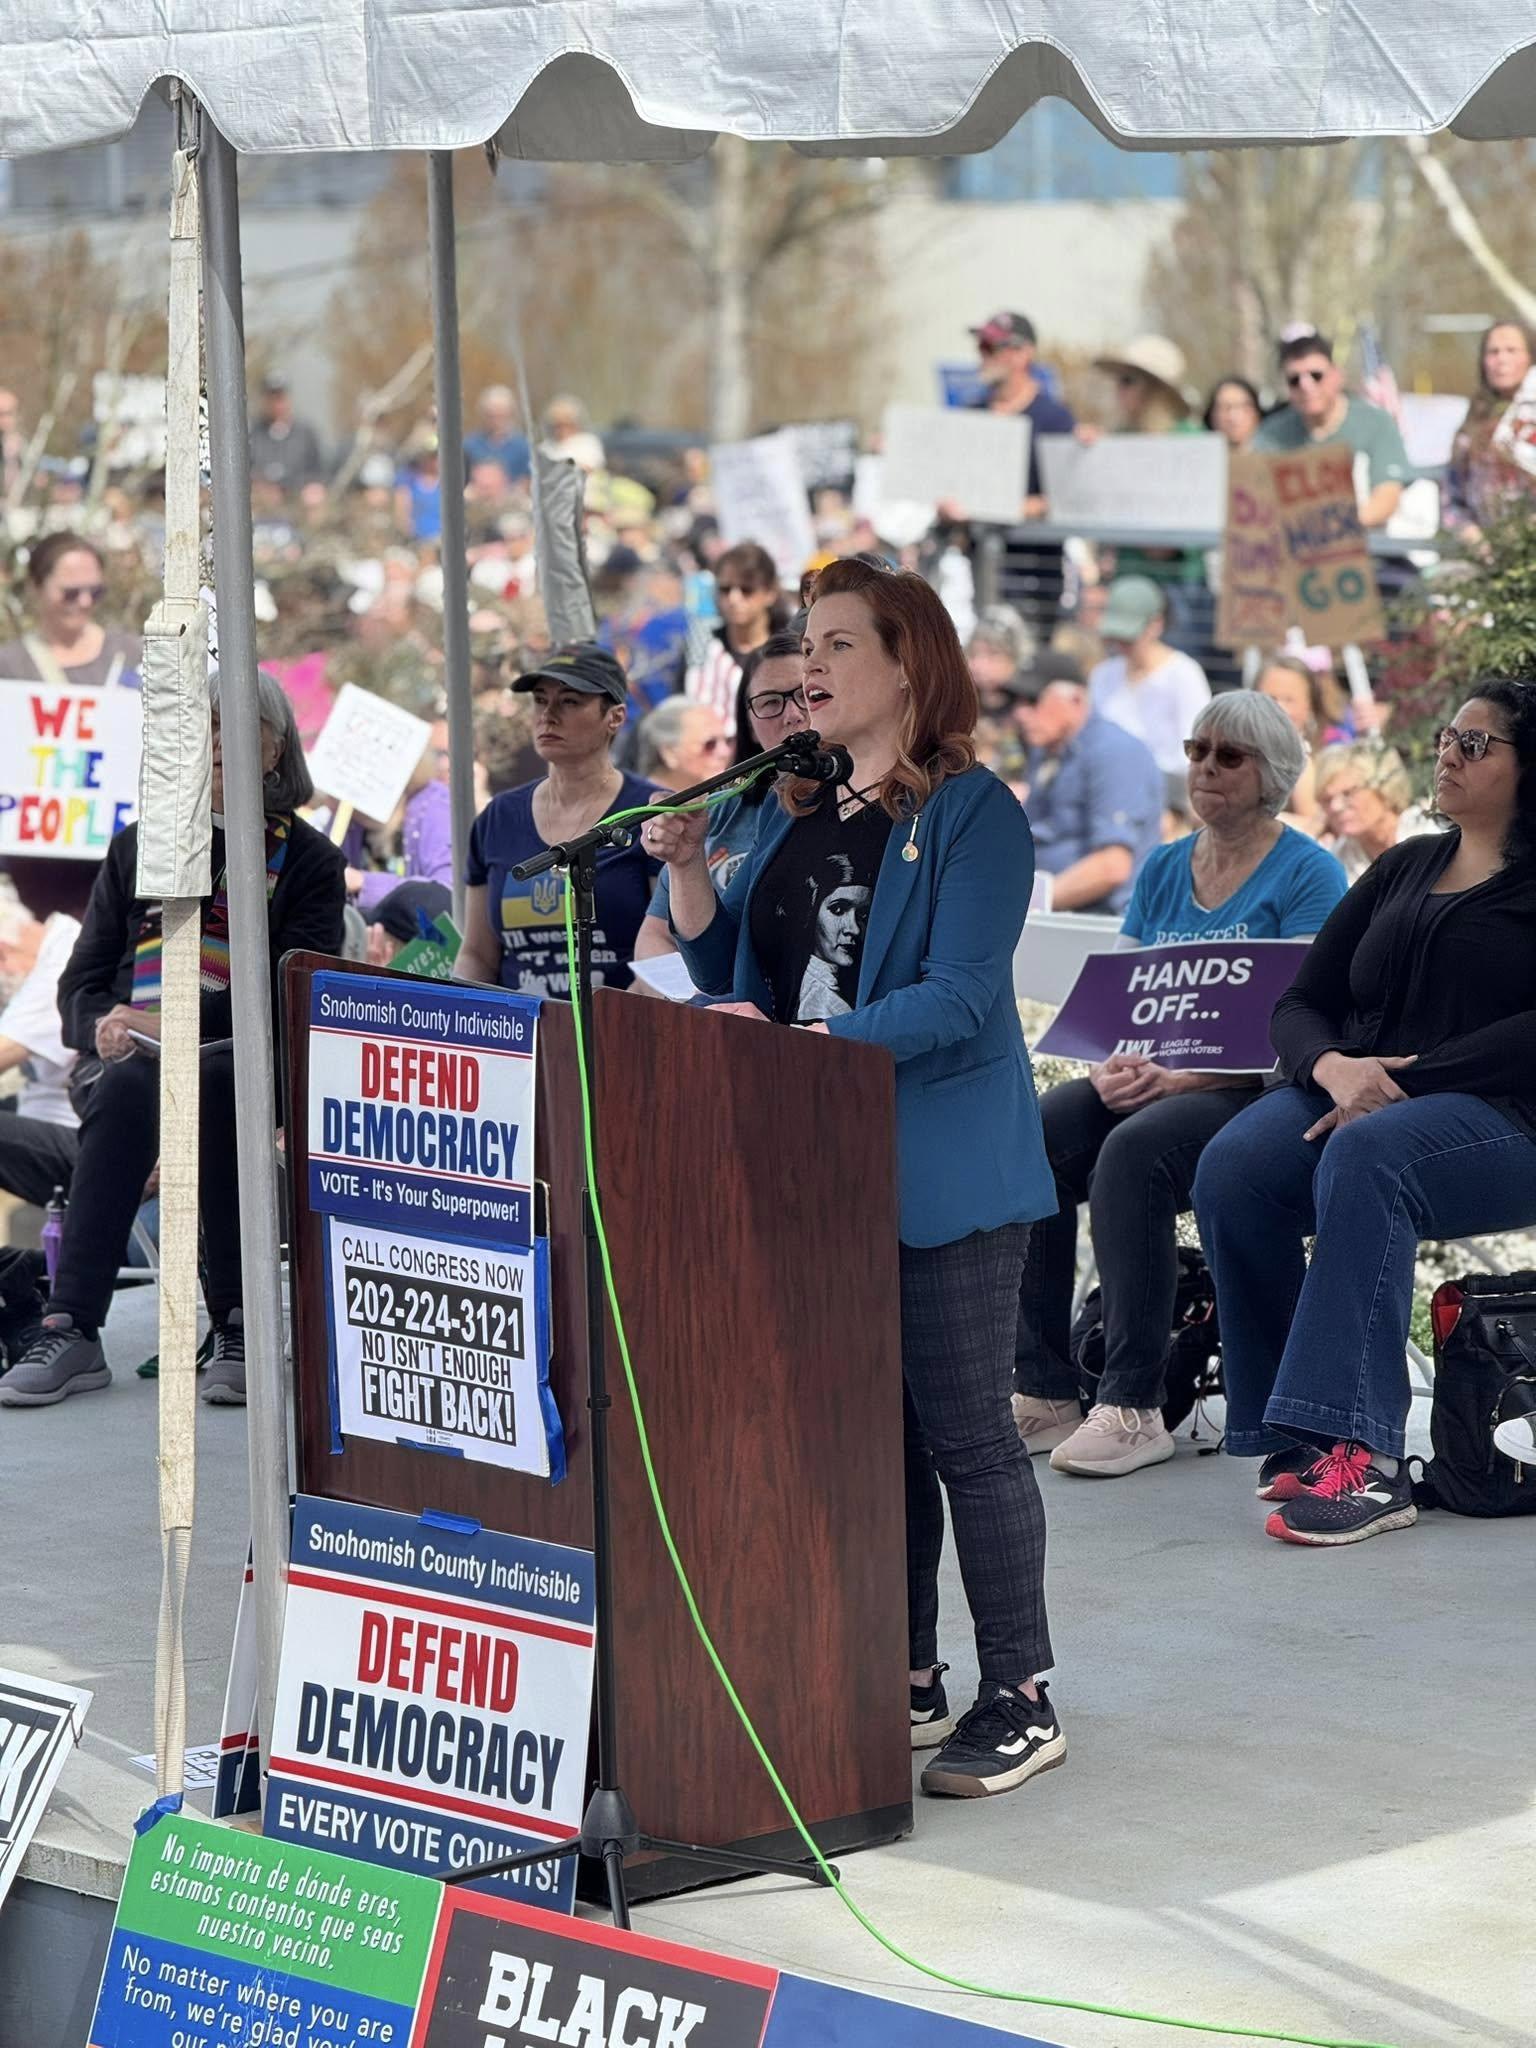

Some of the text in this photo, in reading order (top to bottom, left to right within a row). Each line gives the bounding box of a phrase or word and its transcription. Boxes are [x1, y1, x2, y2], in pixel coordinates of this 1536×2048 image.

[1297, 567, 1366, 611] GO
[30, 695, 96, 739] WE
[28, 746, 103, 788] THE
[1127, 957, 1253, 993] HANDS
[1131, 993, 1220, 1026] OFF...
[320, 993, 524, 1041] Snohomish County Indivisible
[1159, 1047, 1190, 1057] WOMEN
[1160, 1039, 1191, 1049] LEAGUE
[361, 1042, 479, 1112] DEFEND
[323, 1097, 519, 1180] DEMOCRACY
[320, 1171, 360, 1197] VOTE
[372, 1179, 393, 1201] It's
[396, 1182, 428, 1207] Your
[432, 1188, 519, 1222] Superpower!
[342, 1237, 523, 1292] CALL CONGRESS NOW
[348, 1277, 519, 1351] 202-224-3121
[361, 1330, 511, 1389] NO ISN'T ENOUGH
[363, 1366, 513, 1442] FIGHT BACK!
[309, 1523, 580, 1604] Snohomish County Indivisible
[357, 1610, 519, 1714] DEFEND
[296, 1681, 565, 1811] DEMOCRACY
[279, 1793, 367, 1843] EVERY
[374, 1813, 442, 1864] VOTE
[150, 1869, 404, 1955] estamos contentos que seas
[161, 1834, 402, 1928] No importa de dónde eres,
[197, 1912, 335, 1971] nuestro vecino.
[121, 1945, 393, 2043] No matter where you are
[125, 1977, 300, 2048] from, we're glad
[477, 1951, 706, 2048] BLACK
